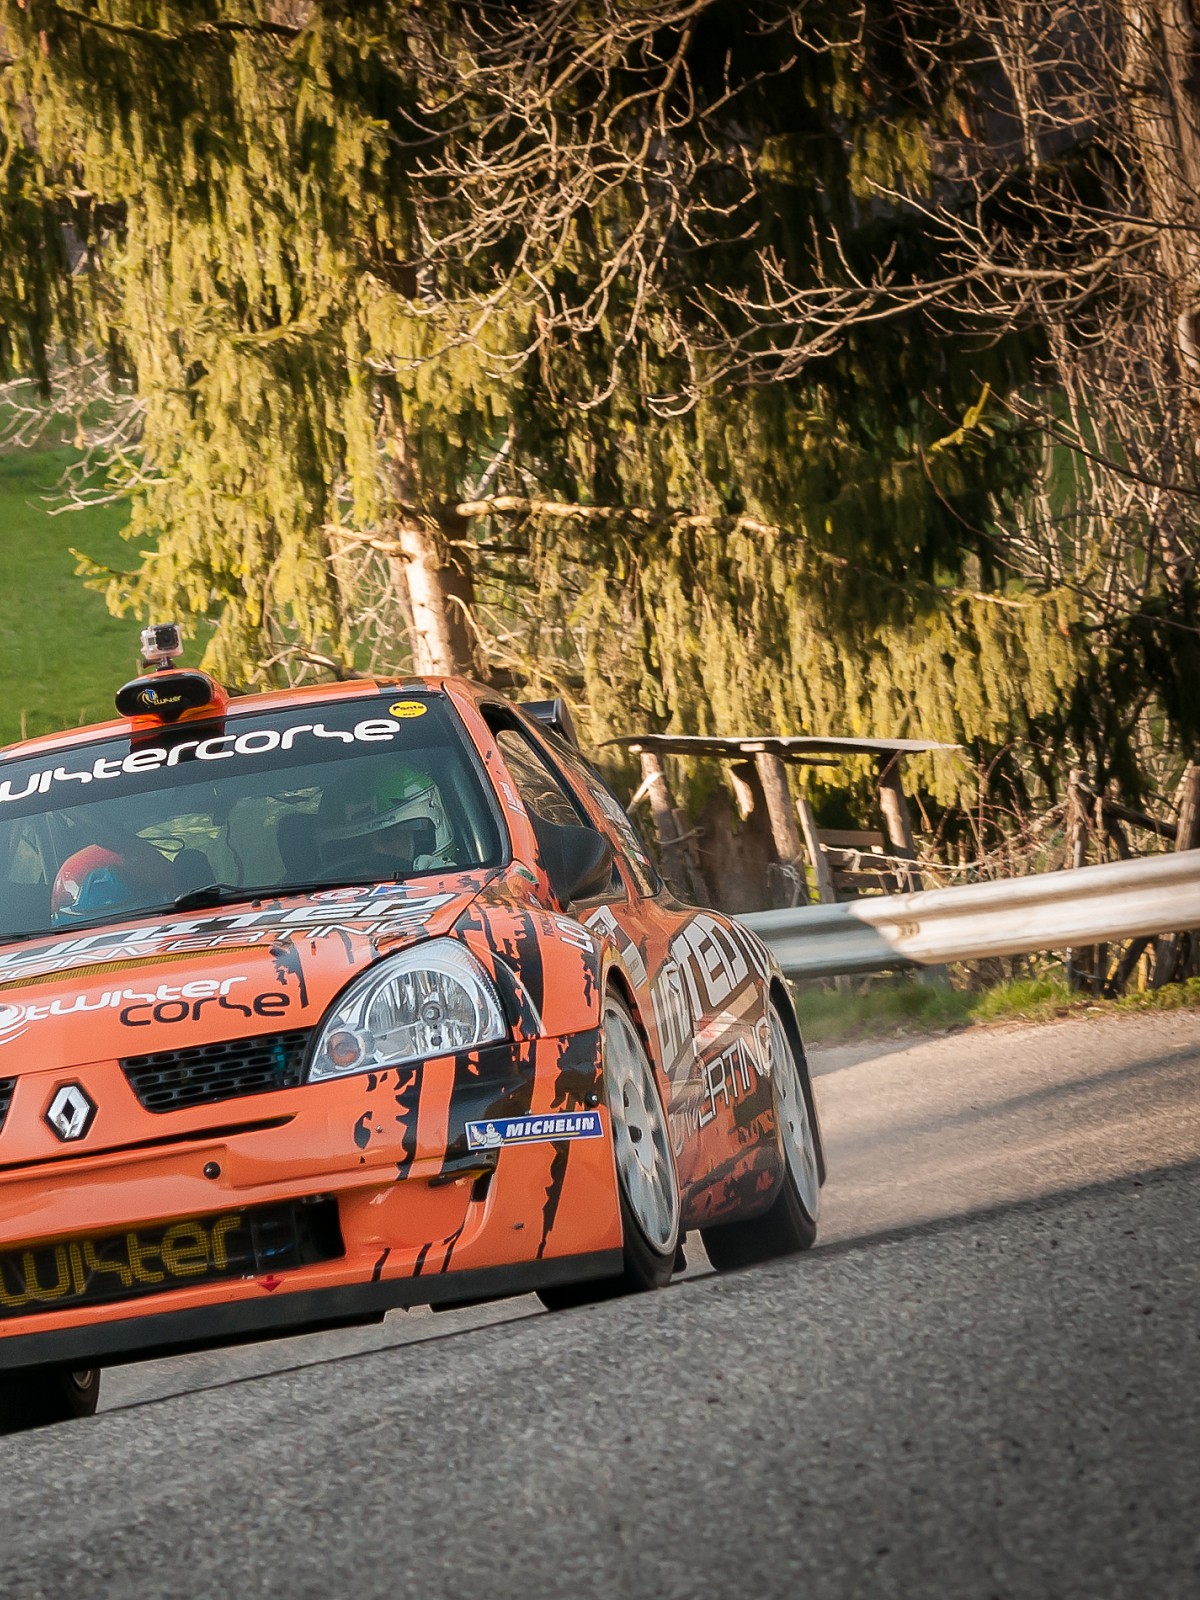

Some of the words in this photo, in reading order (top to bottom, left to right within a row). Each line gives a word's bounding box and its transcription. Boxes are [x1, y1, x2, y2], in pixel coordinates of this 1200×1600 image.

[24, 976, 249, 1024] twister
[119, 988, 290, 1027] corse
[505, 1117, 595, 1138] MICHELIN
